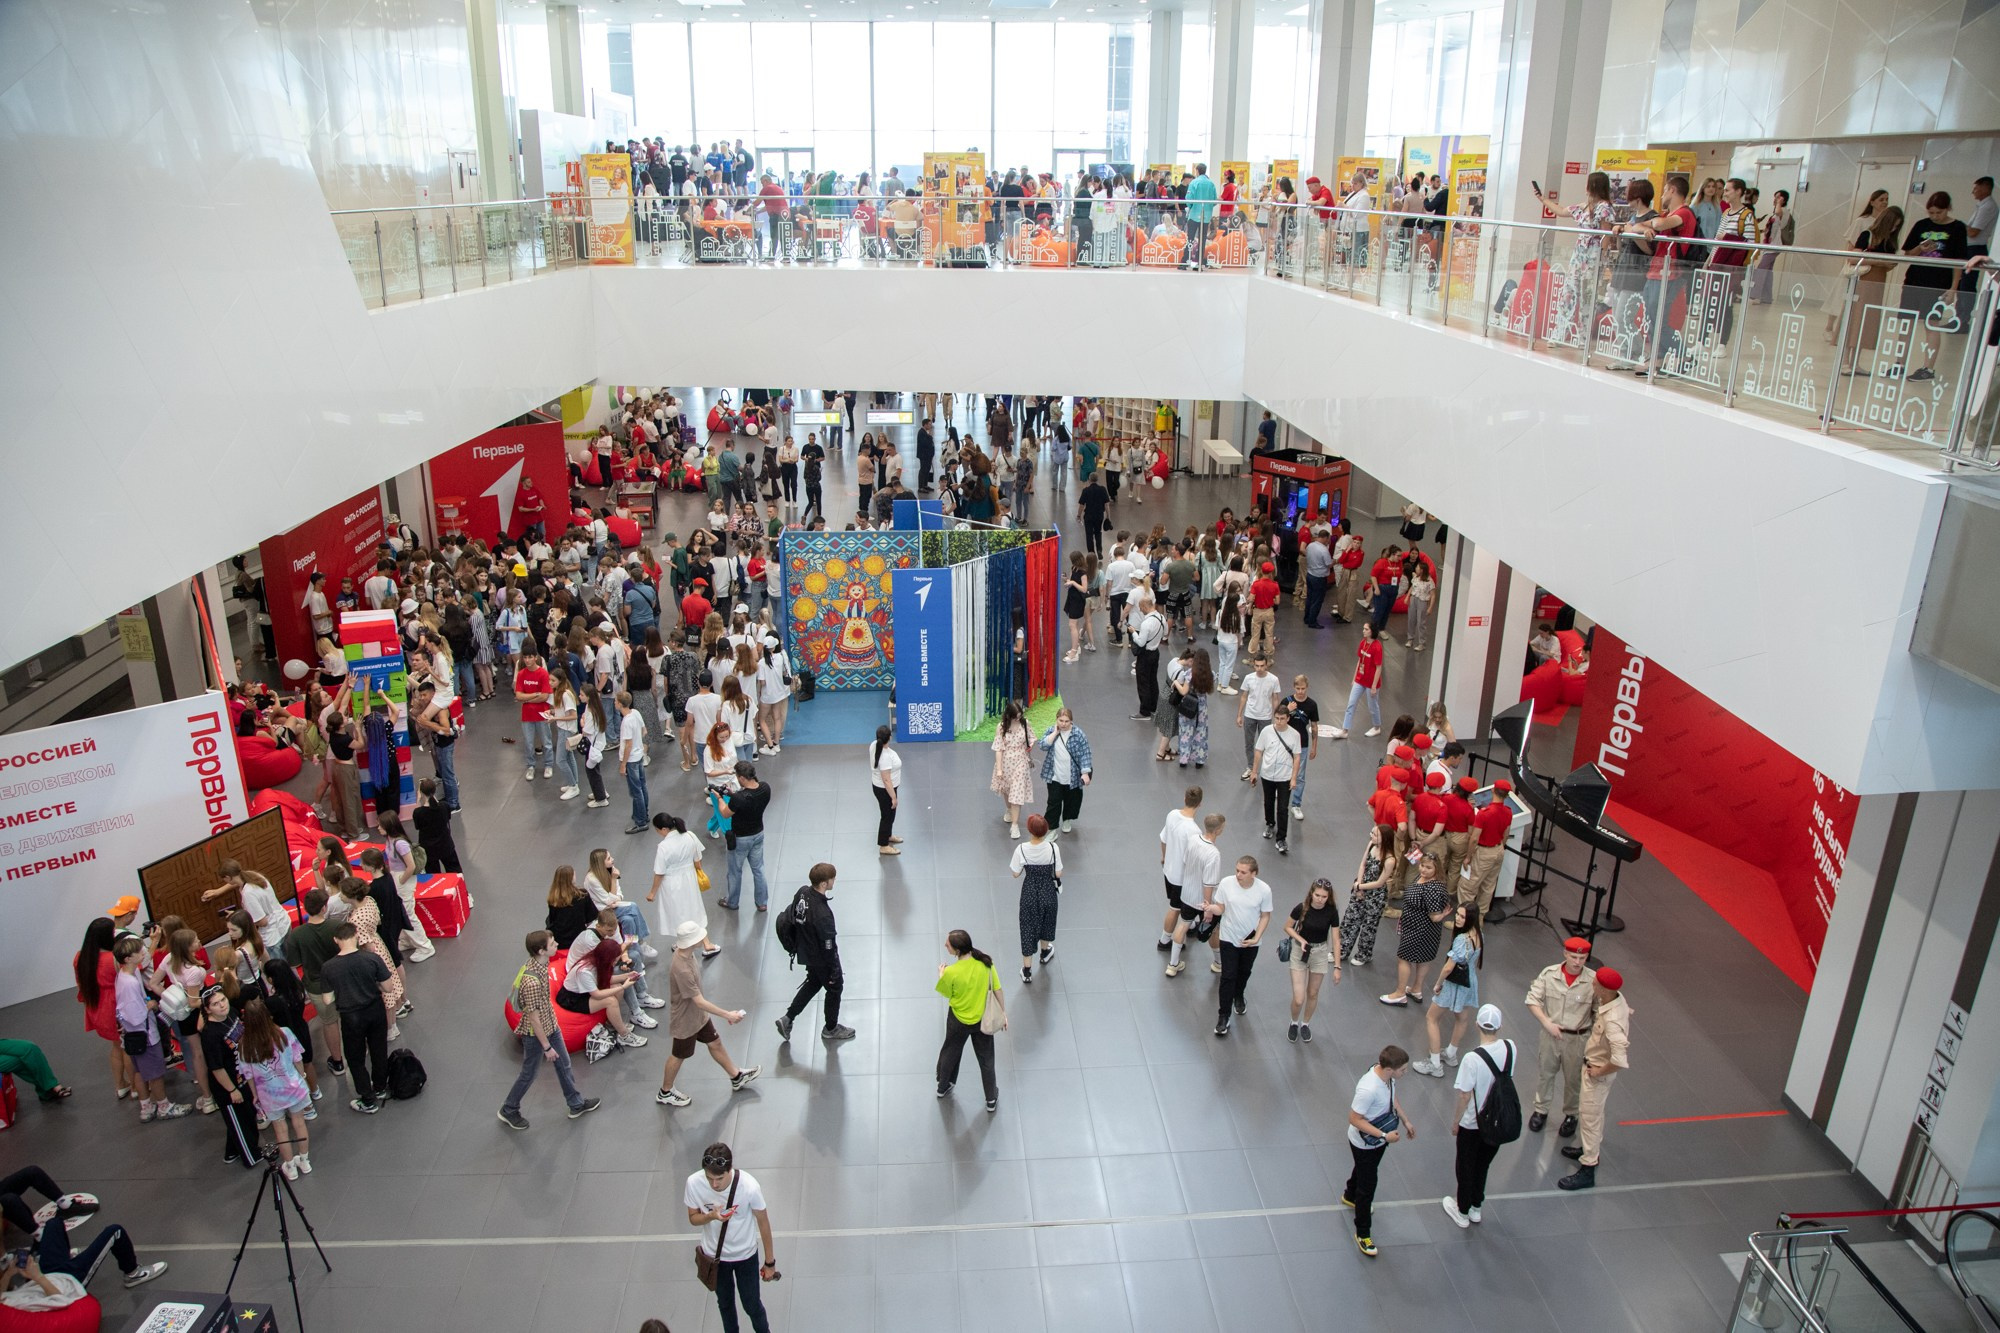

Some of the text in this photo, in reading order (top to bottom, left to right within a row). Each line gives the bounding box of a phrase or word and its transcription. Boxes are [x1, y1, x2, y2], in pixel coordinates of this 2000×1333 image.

[473, 443, 525, 460] Первые
[1270, 461, 1296, 473] Первые
[1323, 465, 1342, 475] Первые
[293, 551, 317, 573] Первые
[920, 628, 929, 686] БЫТЬ ВМЕСТЕ
[0, 737, 97, 771] РОССИЕЙ
[1812, 800, 1825, 829] не
[18, 813, 135, 855] ДВИЖЕНИИ
[6, 848, 97, 881] ПЕРВЫМ
